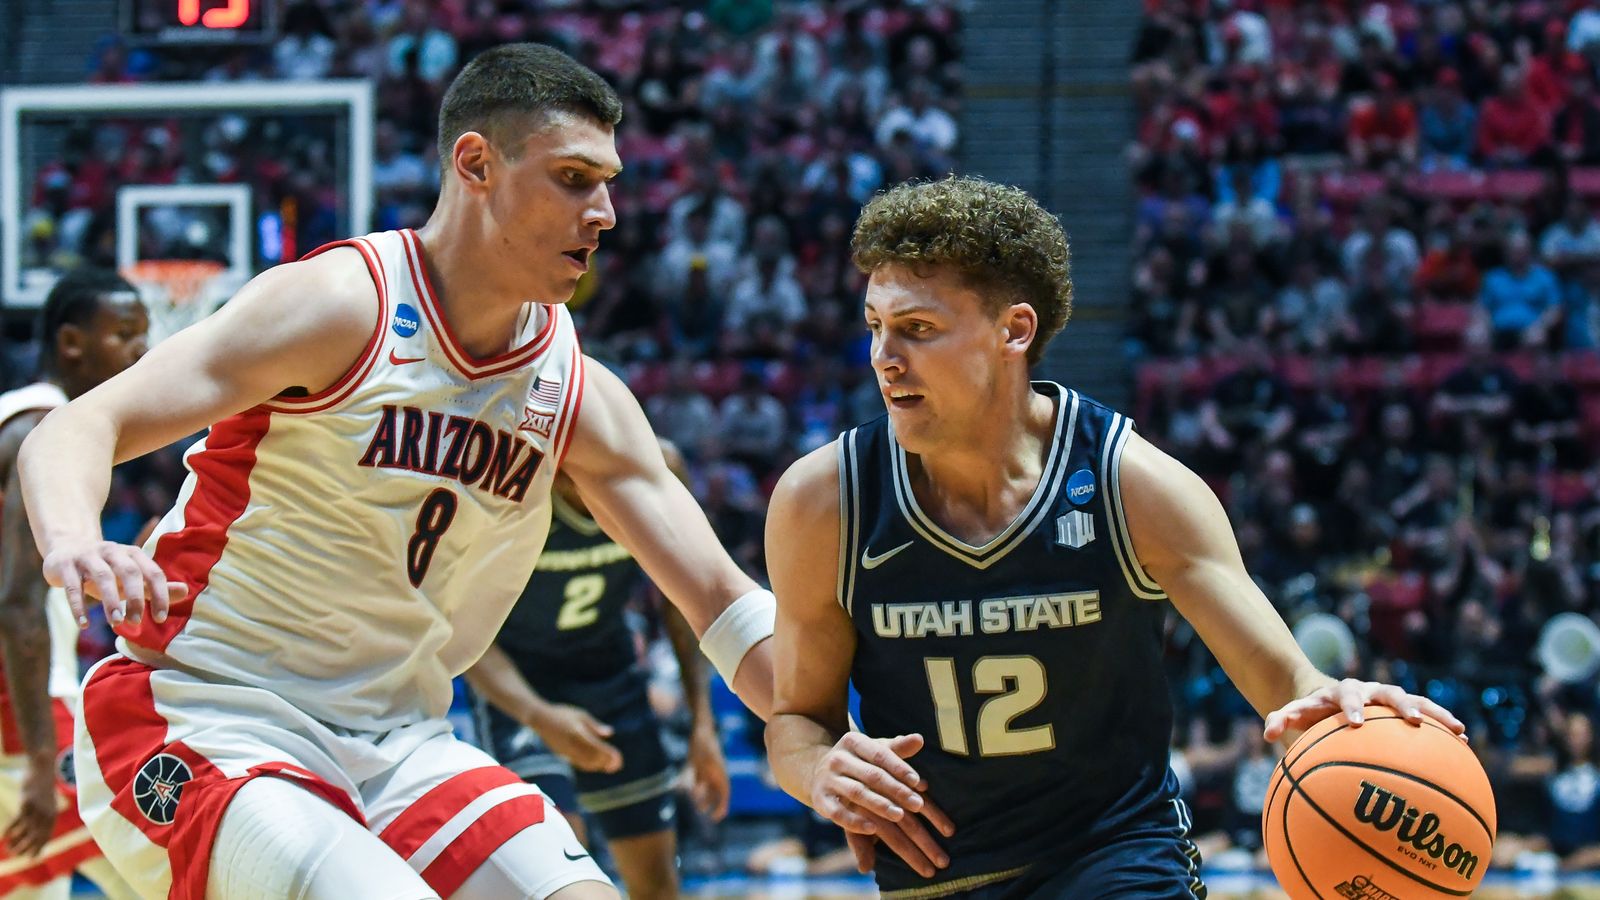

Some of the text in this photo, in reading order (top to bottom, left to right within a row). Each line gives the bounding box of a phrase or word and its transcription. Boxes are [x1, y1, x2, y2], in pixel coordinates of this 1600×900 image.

[394, 316, 418, 330] NCAA
[358, 404, 545, 503] ARIZONA
[1070, 483, 1095, 497] NCAA
[407, 486, 458, 588] 8
[556, 573, 606, 631] 2
[871, 590, 1102, 638] UTAH STATE
[923, 654, 1056, 758] 12
[1353, 778, 1479, 882] Wilson
[1397, 845, 1438, 870] EVO NXT
